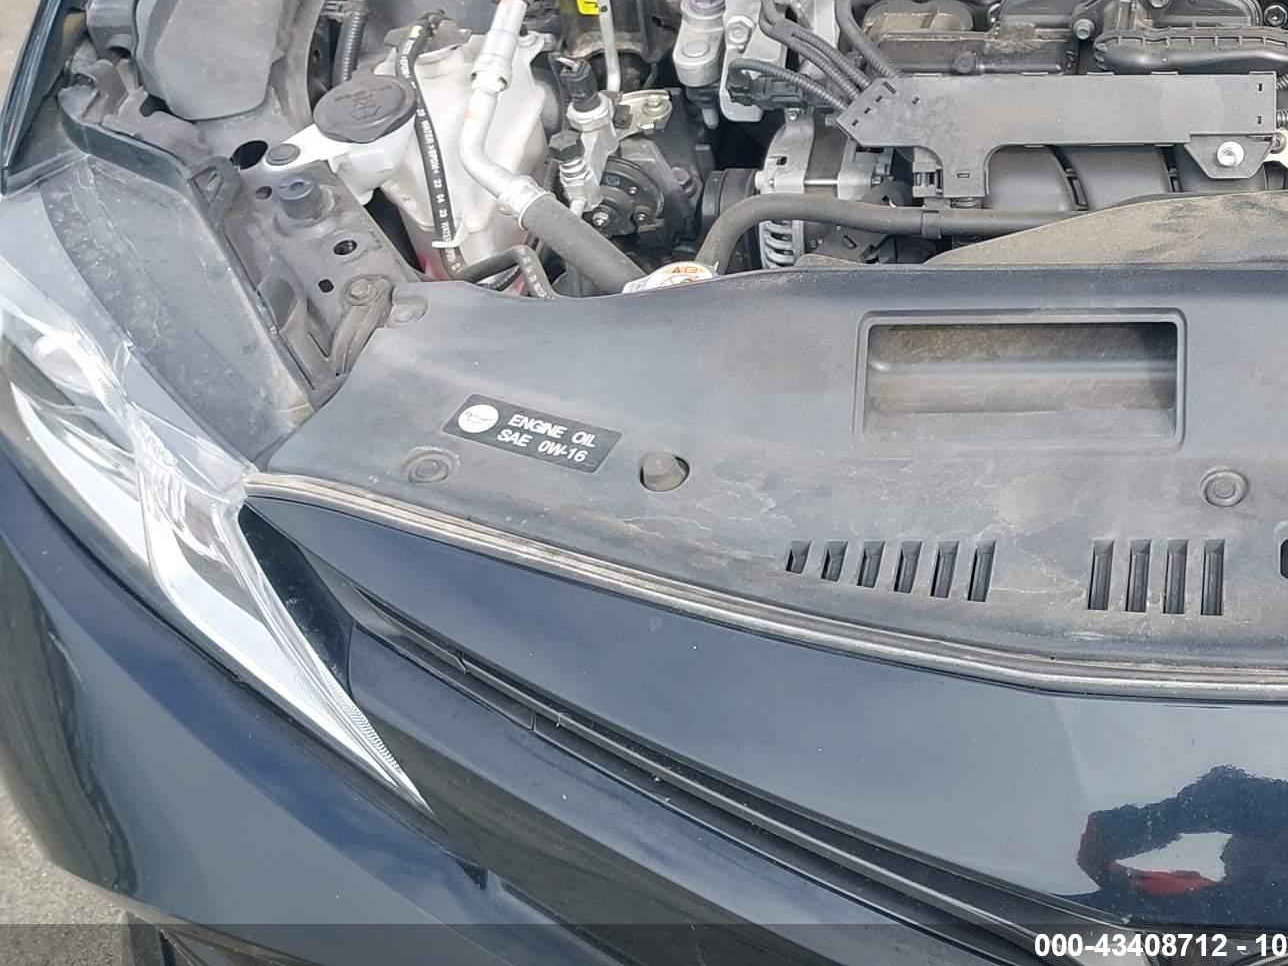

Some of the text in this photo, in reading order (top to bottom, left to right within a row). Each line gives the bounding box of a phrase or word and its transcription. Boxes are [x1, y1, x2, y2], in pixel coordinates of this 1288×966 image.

[421, 119, 434, 144] WATER
[497, 429, 588, 462] SAE 0W-16
[508, 414, 596, 447] ENGINE OIL
